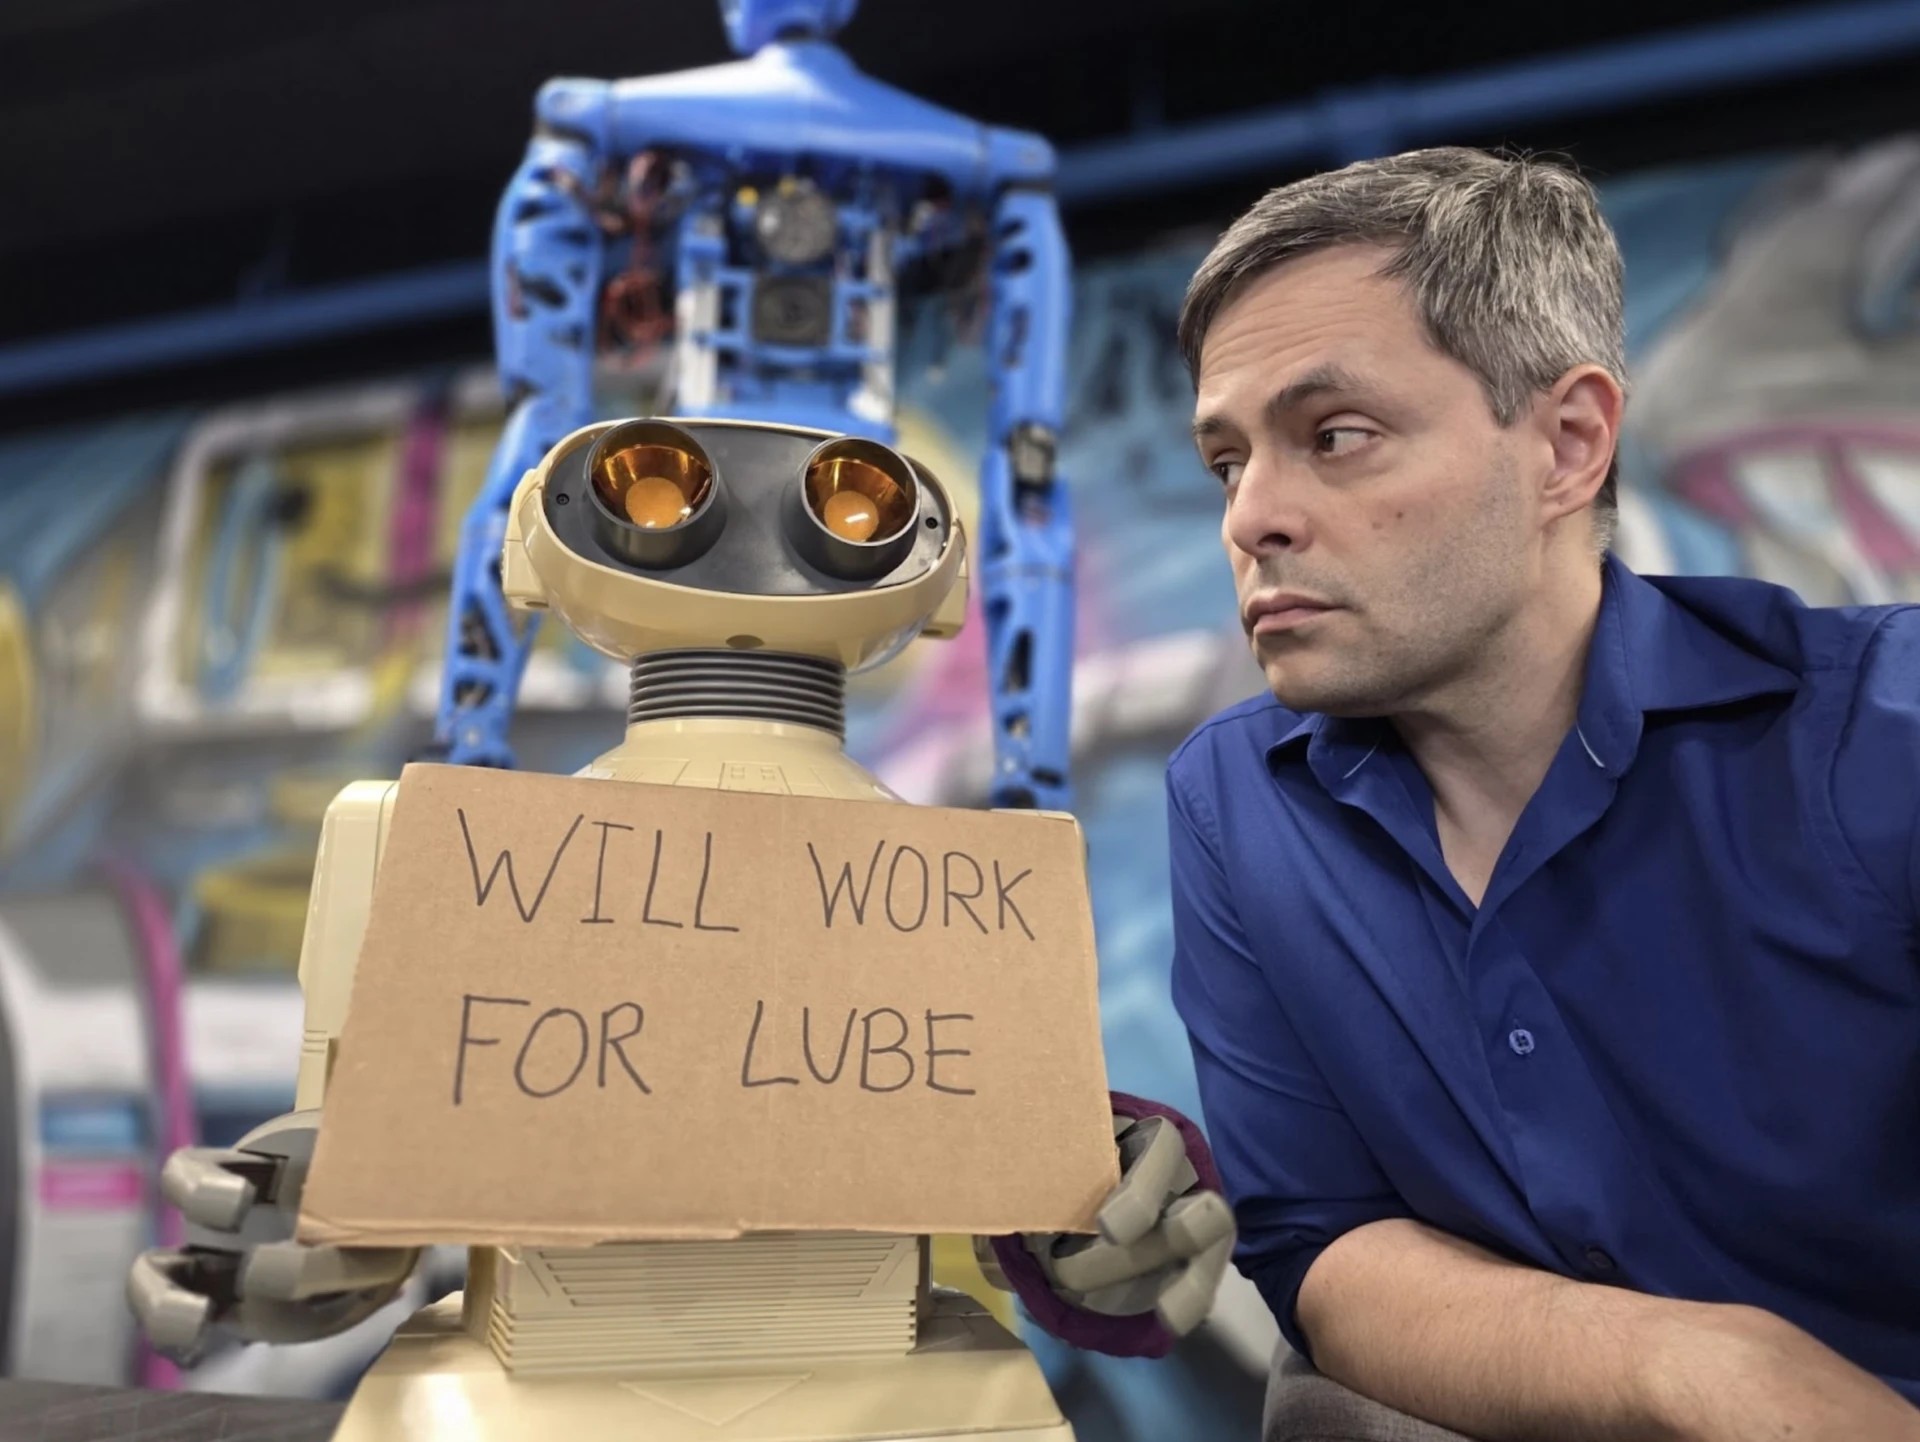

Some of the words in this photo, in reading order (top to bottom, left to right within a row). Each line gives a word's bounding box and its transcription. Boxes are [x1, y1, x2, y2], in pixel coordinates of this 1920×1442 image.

[457, 808, 740, 933] WILL
[807, 839, 1036, 941] WORK
[454, 994, 652, 1107] FOR
[741, 1000, 977, 1096] LUBE
